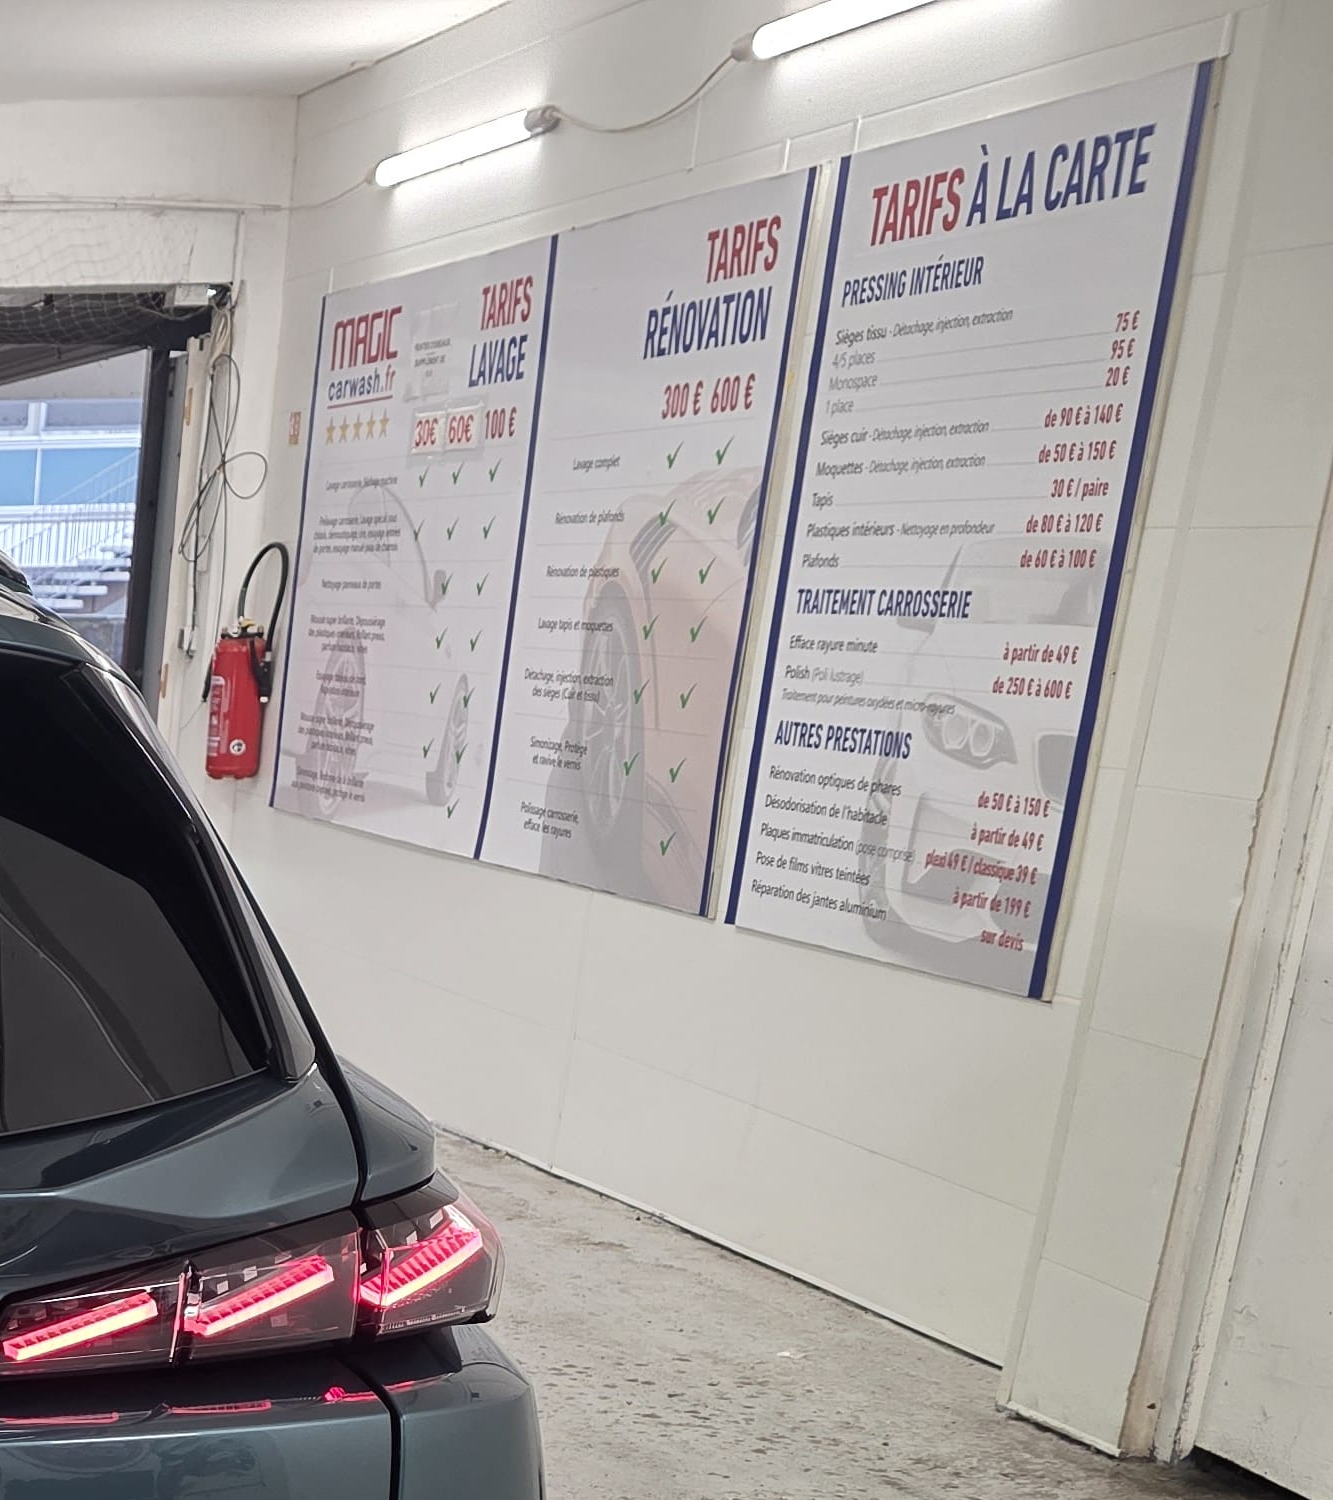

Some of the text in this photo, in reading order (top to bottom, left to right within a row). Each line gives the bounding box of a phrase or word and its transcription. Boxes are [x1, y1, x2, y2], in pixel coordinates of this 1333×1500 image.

[871, 123, 1157, 246] TARIFS À LA CARTE
[707, 215, 781, 284] TARIFS
[842, 255, 984, 307] PRESSING INTÉRIEUR
[481, 275, 533, 331] TARIFS
[643, 286, 772, 360] RÉNOVATION
[1115, 310, 1140, 333] 75 €
[331, 306, 403, 372] MAGIC
[835, 328, 864, 348] Sièges
[1111, 338, 1135, 360] 95 €
[469, 335, 528, 388] LAVAGE
[328, 365, 396, 401] carwash.fr
[1105, 366, 1131, 388] 20 €
[662, 380, 704, 420] 300 €
[711, 373, 755, 413] 600 €
[449, 414, 474, 444] 60€
[485, 406, 517, 440] 100 €
[1045, 403, 1124, 428] de 90 € à 140 €
[415, 418, 438, 447] 30€
[1039, 440, 1117, 464] de 50 € à 150 €
[1051, 479, 1065, 498] 30
[1067, 478, 1074, 497] €
[1081, 477, 1109, 502] paire
[1026, 513, 1104, 534] de 80 € à 120 €
[1021, 549, 1097, 569] de 60 € à 100 €
[797, 589, 972, 618] TRAITEMENT CARROSSERIE
[1003, 642, 1079, 666] à partir de 49 €
[993, 676, 1073, 699] de 250 € à 600 €
[775, 720, 912, 760] AUTRES PRESTATIONS
[769, 765, 815, 785] Rénovation
[818, 772, 856, 792] optiques
[857, 776, 869, 793] de
[829, 802, 840, 818] de
[978, 791, 1051, 818] de 50 € à 150 €
[971, 822, 1045, 852] à partir de 49 €
[756, 851, 775, 867] Pose
[776, 853, 787, 869] de
[788, 857, 809, 876] films
[811, 860, 834, 880] vitres
[961, 853, 968, 872] €
[1016, 865, 1029, 885] 39
[1030, 868, 1038, 886] €
[751, 879, 794, 900] Réparation
[796, 888, 811, 904] des
[810, 892, 838, 911] jantes
[952, 886, 1031, 919] à partir de 199 €
[980, 929, 1024, 952] sur devis
